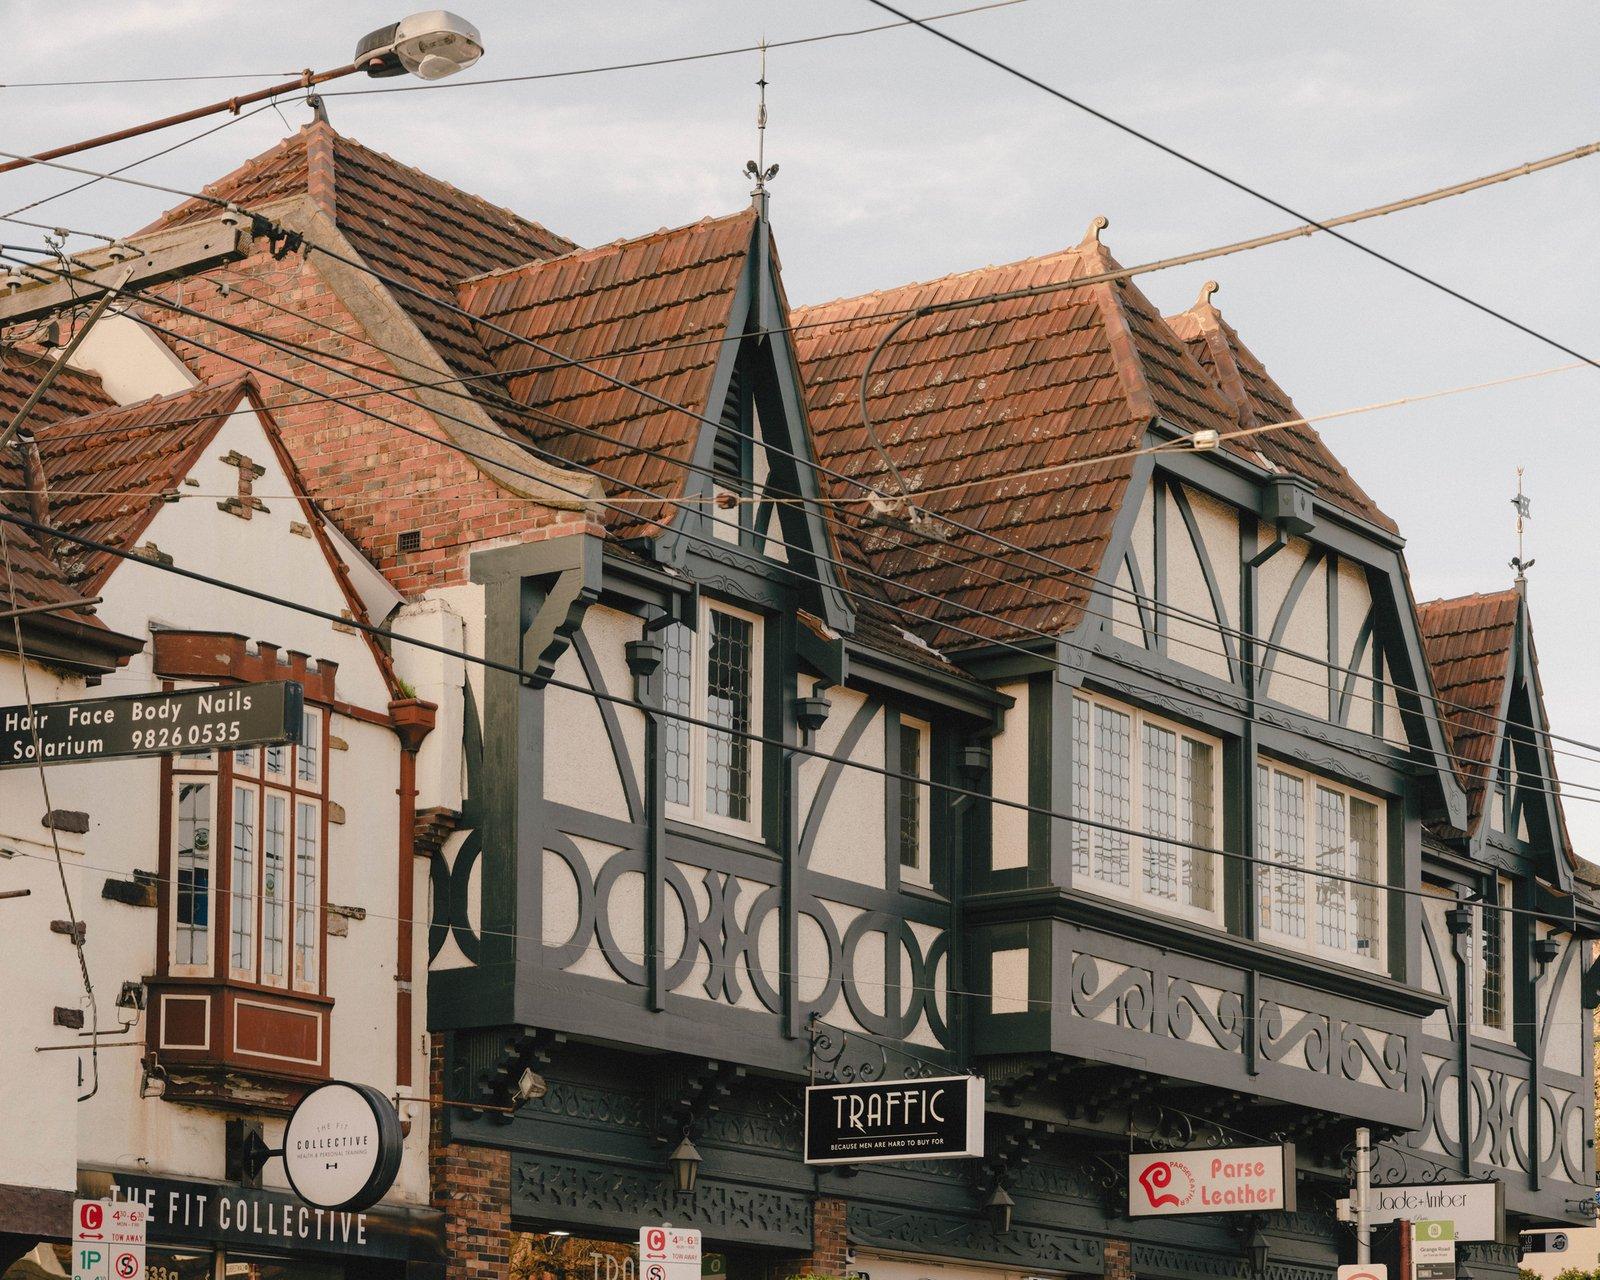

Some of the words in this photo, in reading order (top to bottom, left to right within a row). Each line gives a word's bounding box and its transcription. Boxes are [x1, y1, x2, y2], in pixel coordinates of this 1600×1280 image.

[5, 712, 48, 732] Hair
[68, 706, 116, 726] Face
[131, 698, 182, 723] Body
[197, 690, 253, 715] Nails
[13, 736, 104, 760] Solarium
[131, 726, 182, 750] 9826
[188, 720, 241, 745] 0535
[832, 1088, 946, 1134] TRAFFIC
[297, 1135, 368, 1150] COLLECTIVE
[830, 1143, 857, 1151] BECAUSE
[1211, 1158, 1265, 1179] Parse
[1201, 1183, 1276, 1206] Leather
[168, 1192, 207, 1228] FIT
[219, 1197, 368, 1245] COLLECTIVE
[112, 1233, 124, 1241] TOW
[126, 1234, 144, 1242] AWAY
[80, 1250, 102, 1270] 1P
